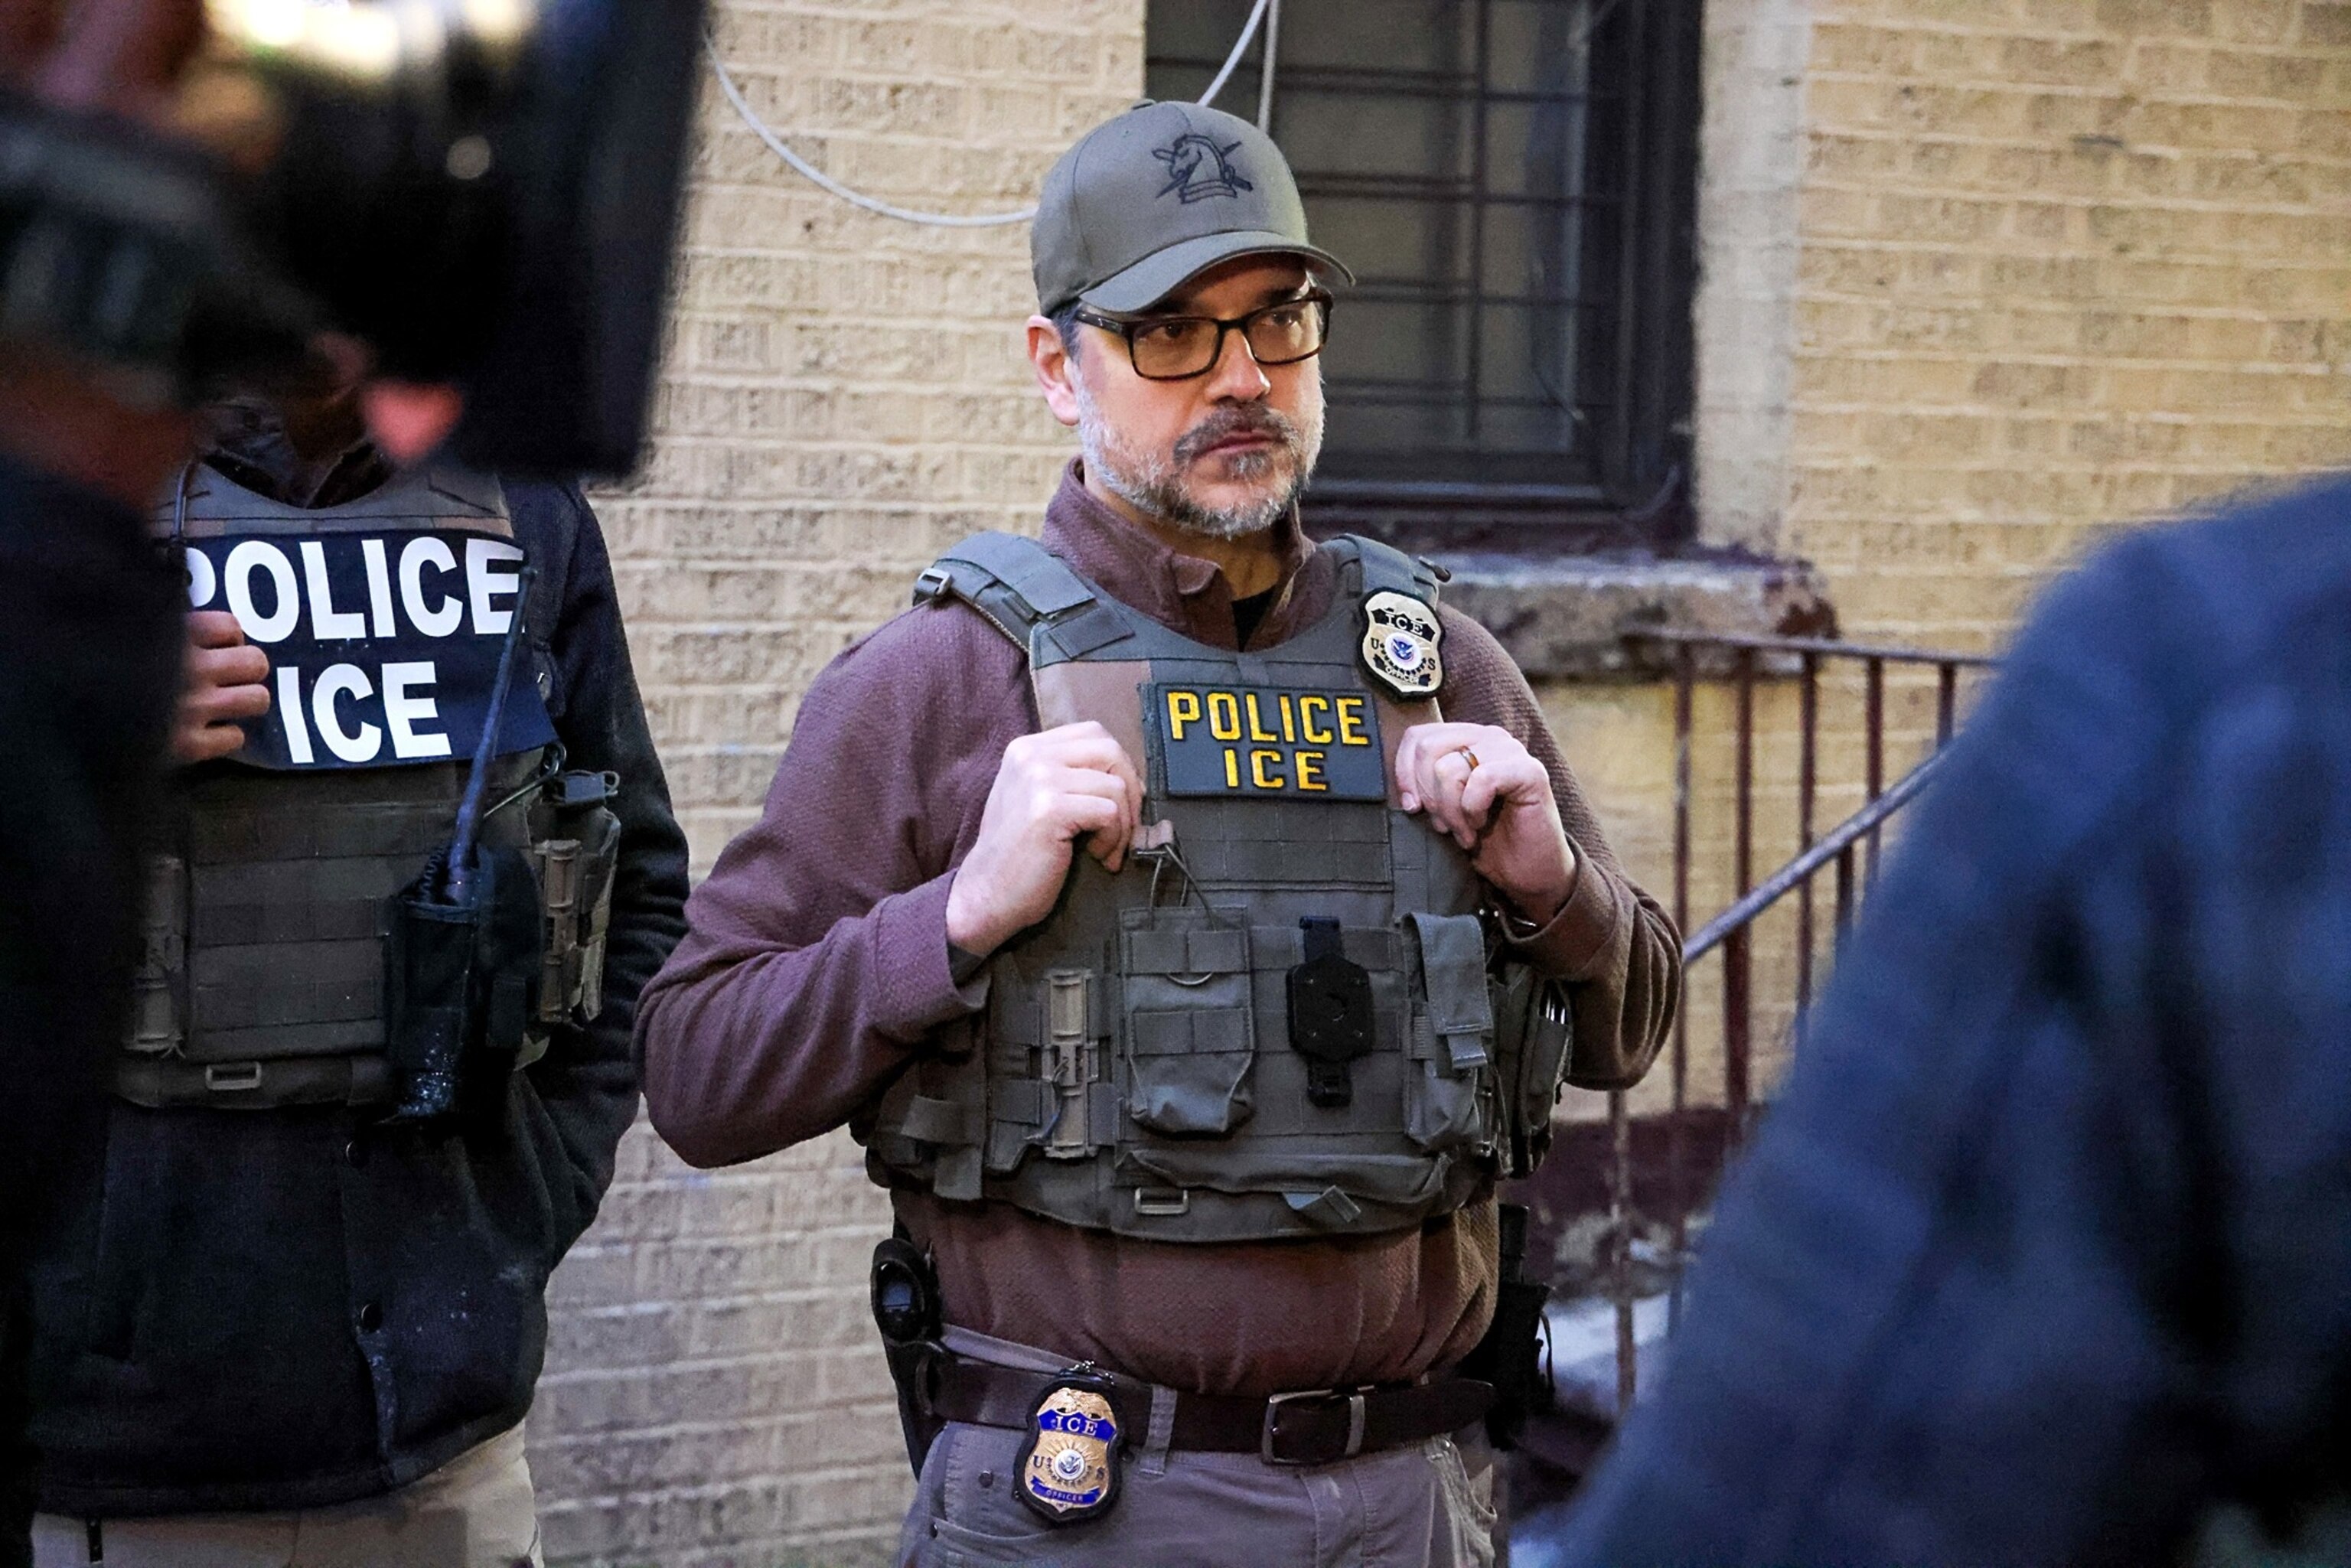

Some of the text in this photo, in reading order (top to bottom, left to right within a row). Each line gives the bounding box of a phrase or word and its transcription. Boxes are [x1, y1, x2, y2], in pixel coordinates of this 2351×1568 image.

[1386, 613, 1423, 636] ICE
[1371, 637, 1436, 670] U S
[1384, 666, 1419, 685] OFFICER
[276, 663, 452, 764] ICE
[1167, 691, 1369, 745] POLICE
[1224, 749, 1327, 791] ICE
[1055, 1416, 1099, 1436] ICE
[1033, 1456, 1105, 1480] U S
[1045, 1489, 1084, 1502] OFFICER
